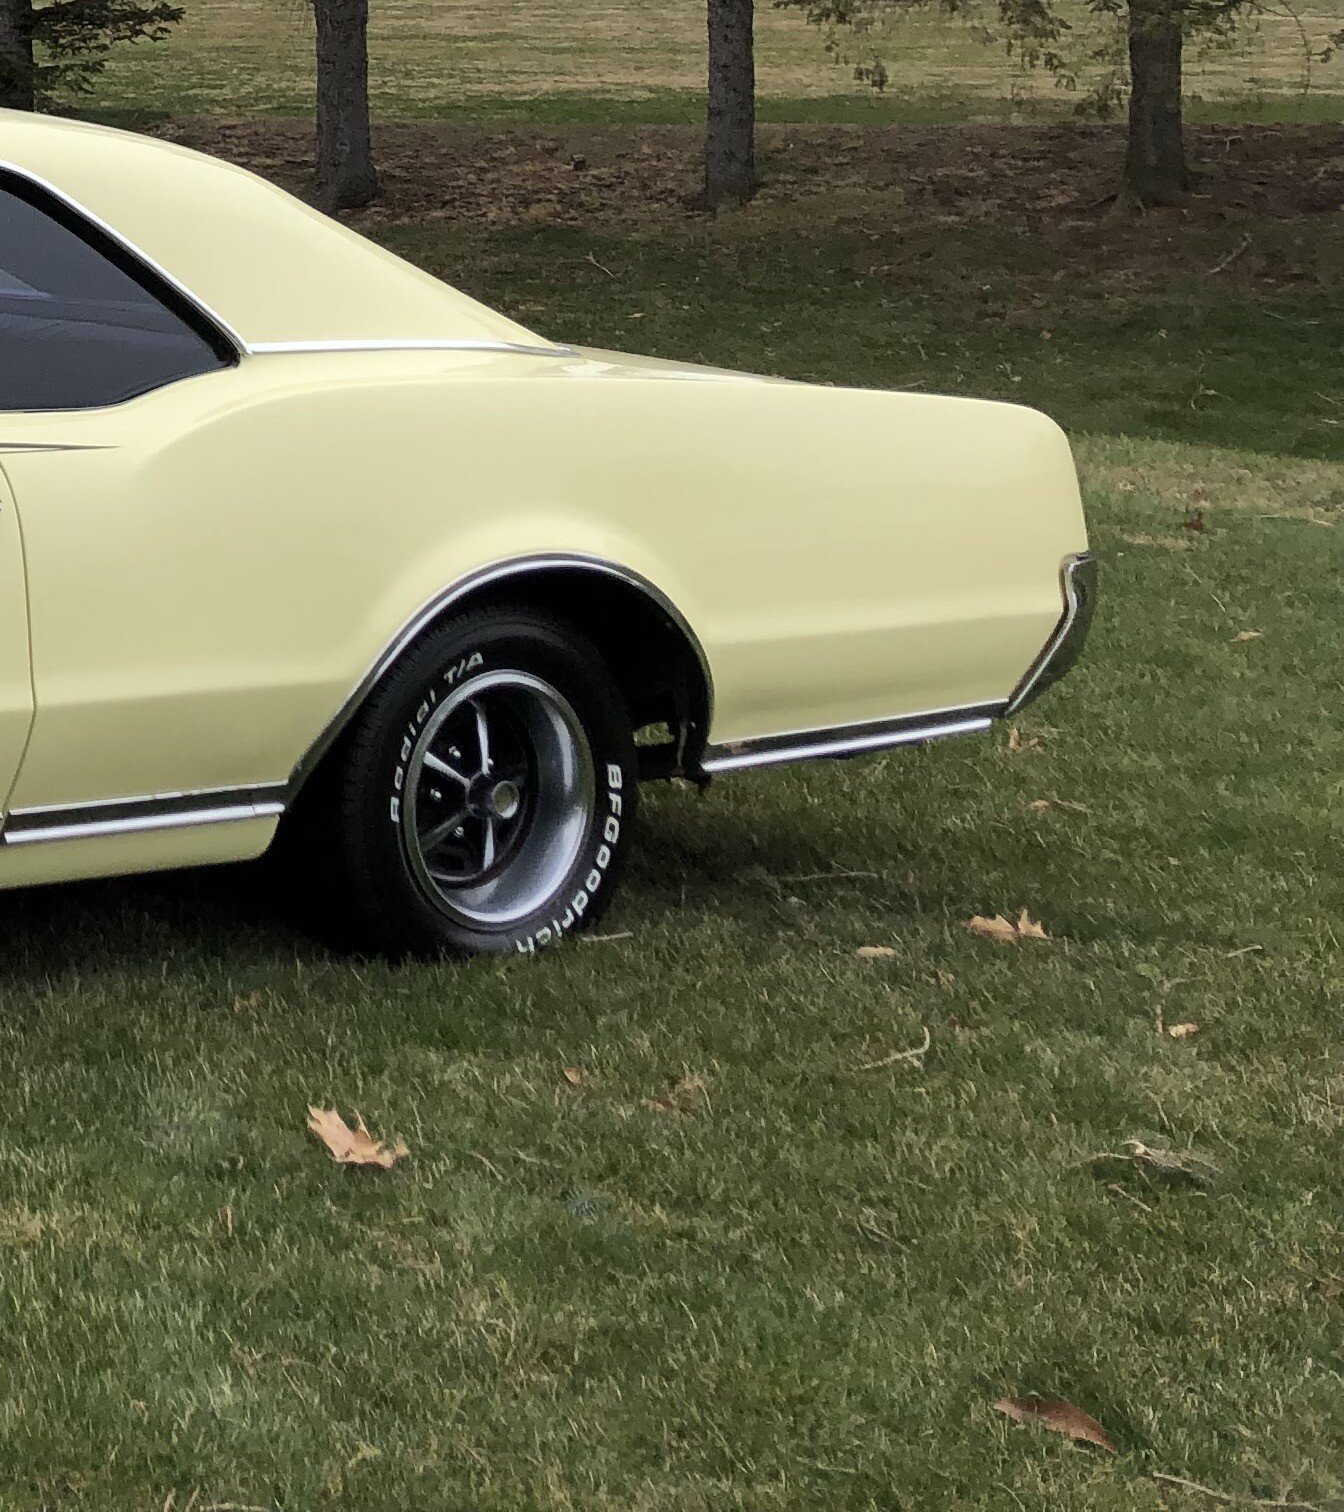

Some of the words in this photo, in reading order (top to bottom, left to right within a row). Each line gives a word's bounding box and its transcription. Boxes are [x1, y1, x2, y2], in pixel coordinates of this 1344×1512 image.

[390, 690, 436, 823] Radial
[443, 652, 484, 684] T/A
[515, 763, 623, 955] BFGoodrich
